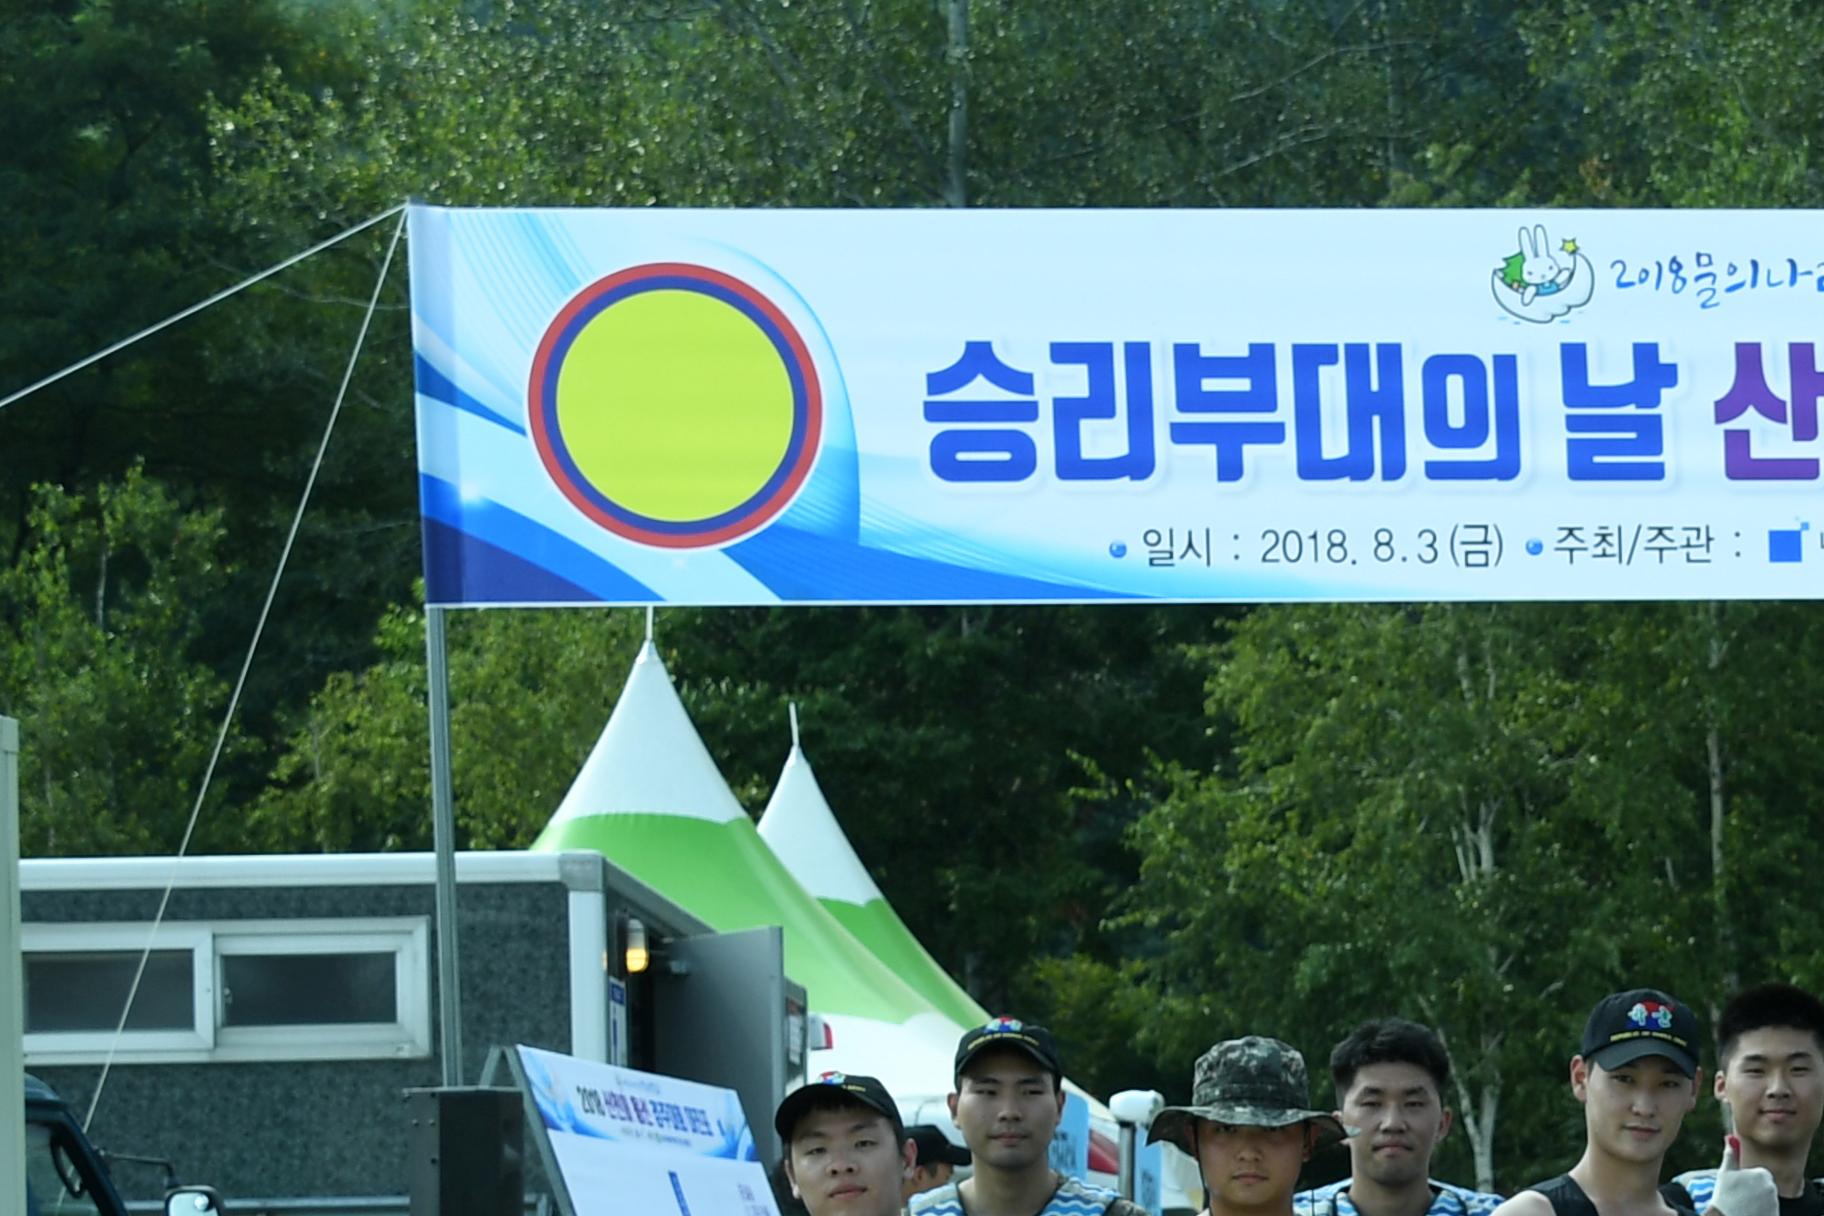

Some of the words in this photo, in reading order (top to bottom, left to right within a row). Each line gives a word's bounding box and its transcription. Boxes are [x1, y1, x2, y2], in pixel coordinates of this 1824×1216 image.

[922, 340, 1522, 482] 승리부대의
[1559, 341, 1679, 482] 날
[1143, 526, 1212, 568] 일시
[1553, 523, 1716, 566] 주최/주관
